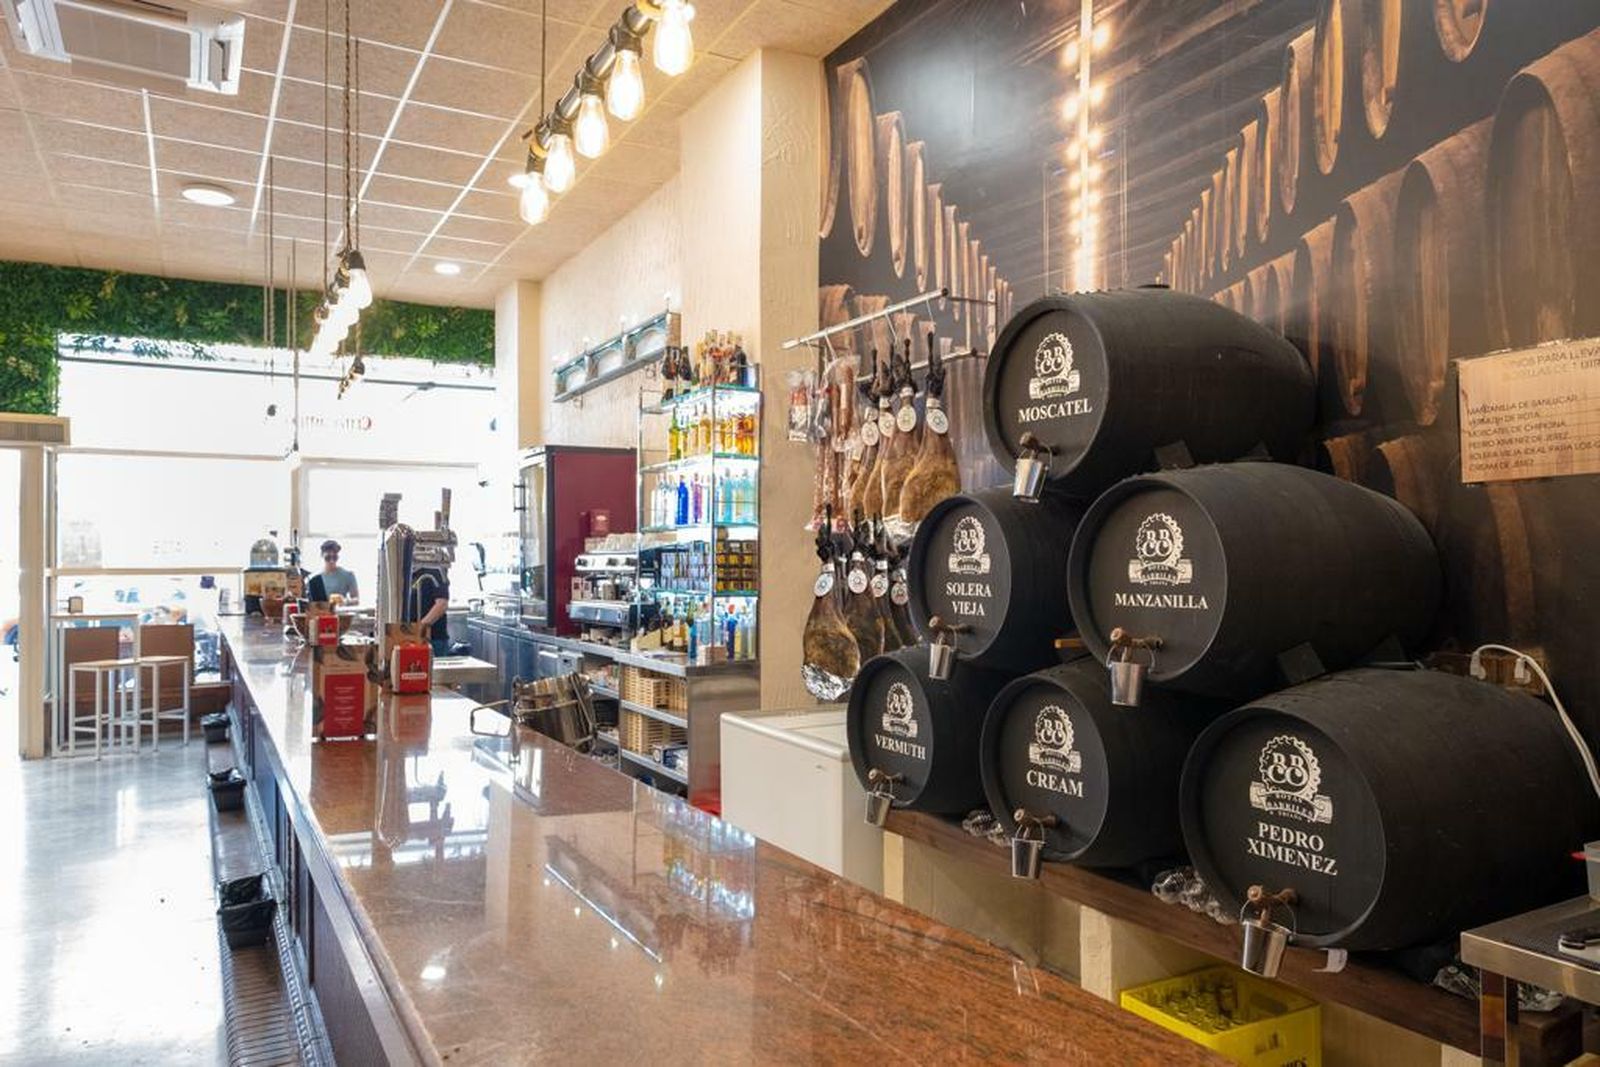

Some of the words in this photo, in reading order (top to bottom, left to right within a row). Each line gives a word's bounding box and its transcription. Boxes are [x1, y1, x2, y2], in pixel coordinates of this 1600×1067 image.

[1536, 350, 1567, 366] PARA
[1018, 398, 1093, 423] MOSCATEL
[945, 582, 992, 597] SOLERA
[1114, 592, 1209, 610] MANZANILLA
[952, 601, 985, 616] VIEJA
[874, 733, 926, 760] VERMUTH
[1026, 769, 1084, 798] CREAM
[1258, 821, 1324, 852] PEDRO
[1247, 837, 1338, 876] XIMENEZ
